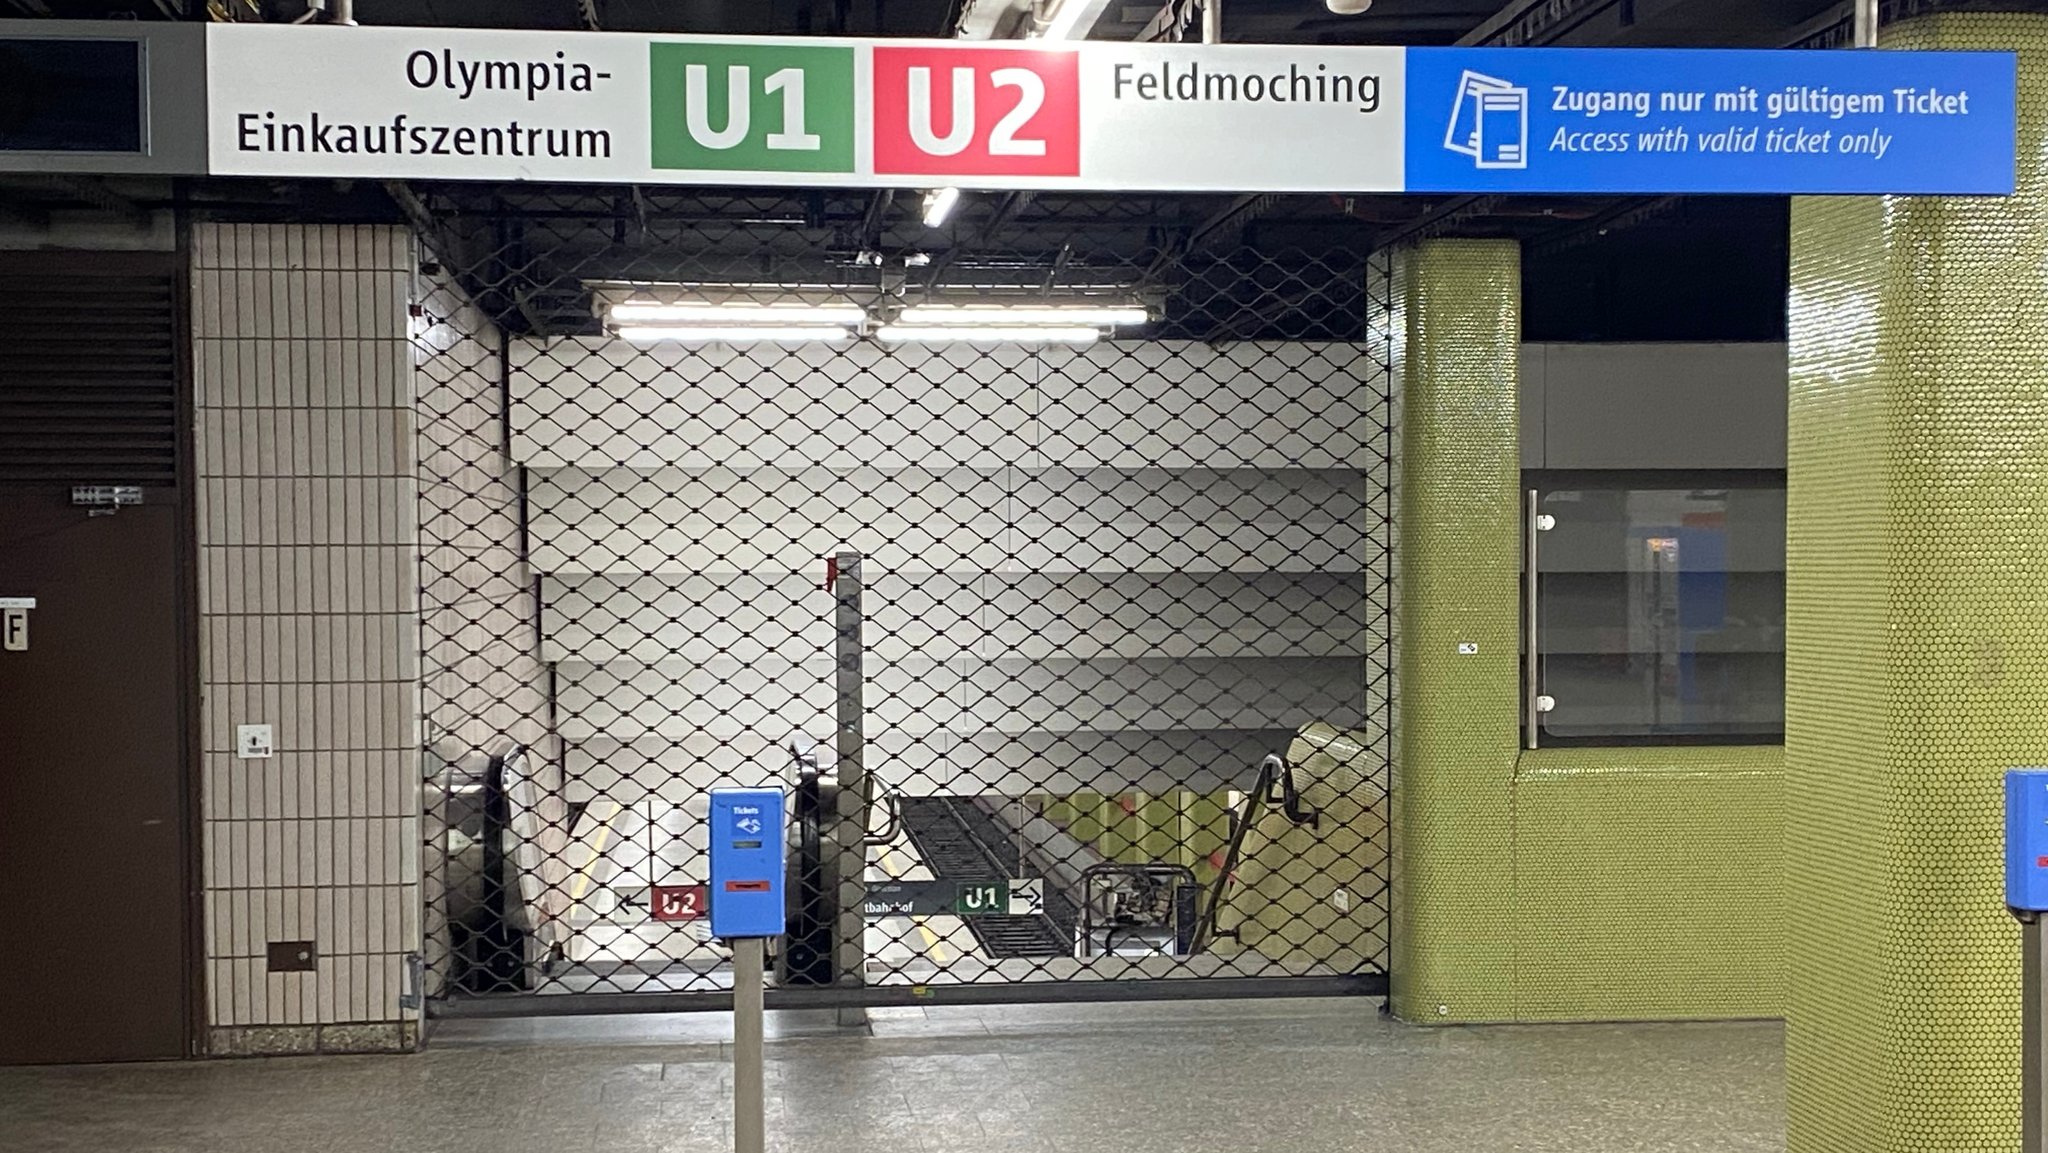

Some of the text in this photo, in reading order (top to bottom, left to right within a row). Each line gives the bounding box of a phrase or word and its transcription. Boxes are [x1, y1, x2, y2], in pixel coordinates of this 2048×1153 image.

[406, 48, 611, 101] Olympia-
[1114, 62, 1380, 113] Feldmoching
[685, 64, 821, 151] U1
[908, 66, 1047, 156] U2
[1551, 85, 1969, 119] Zugang nur mit gültigem Ticket
[237, 111, 612, 158] Einkaufszentrum
[1549, 125, 1893, 160] Access with valid ticket only
[9, 614, 23, 645] F
[733, 806, 759, 815] Tickets
[661, 892, 697, 915] U2
[965, 887, 999, 909] U1
